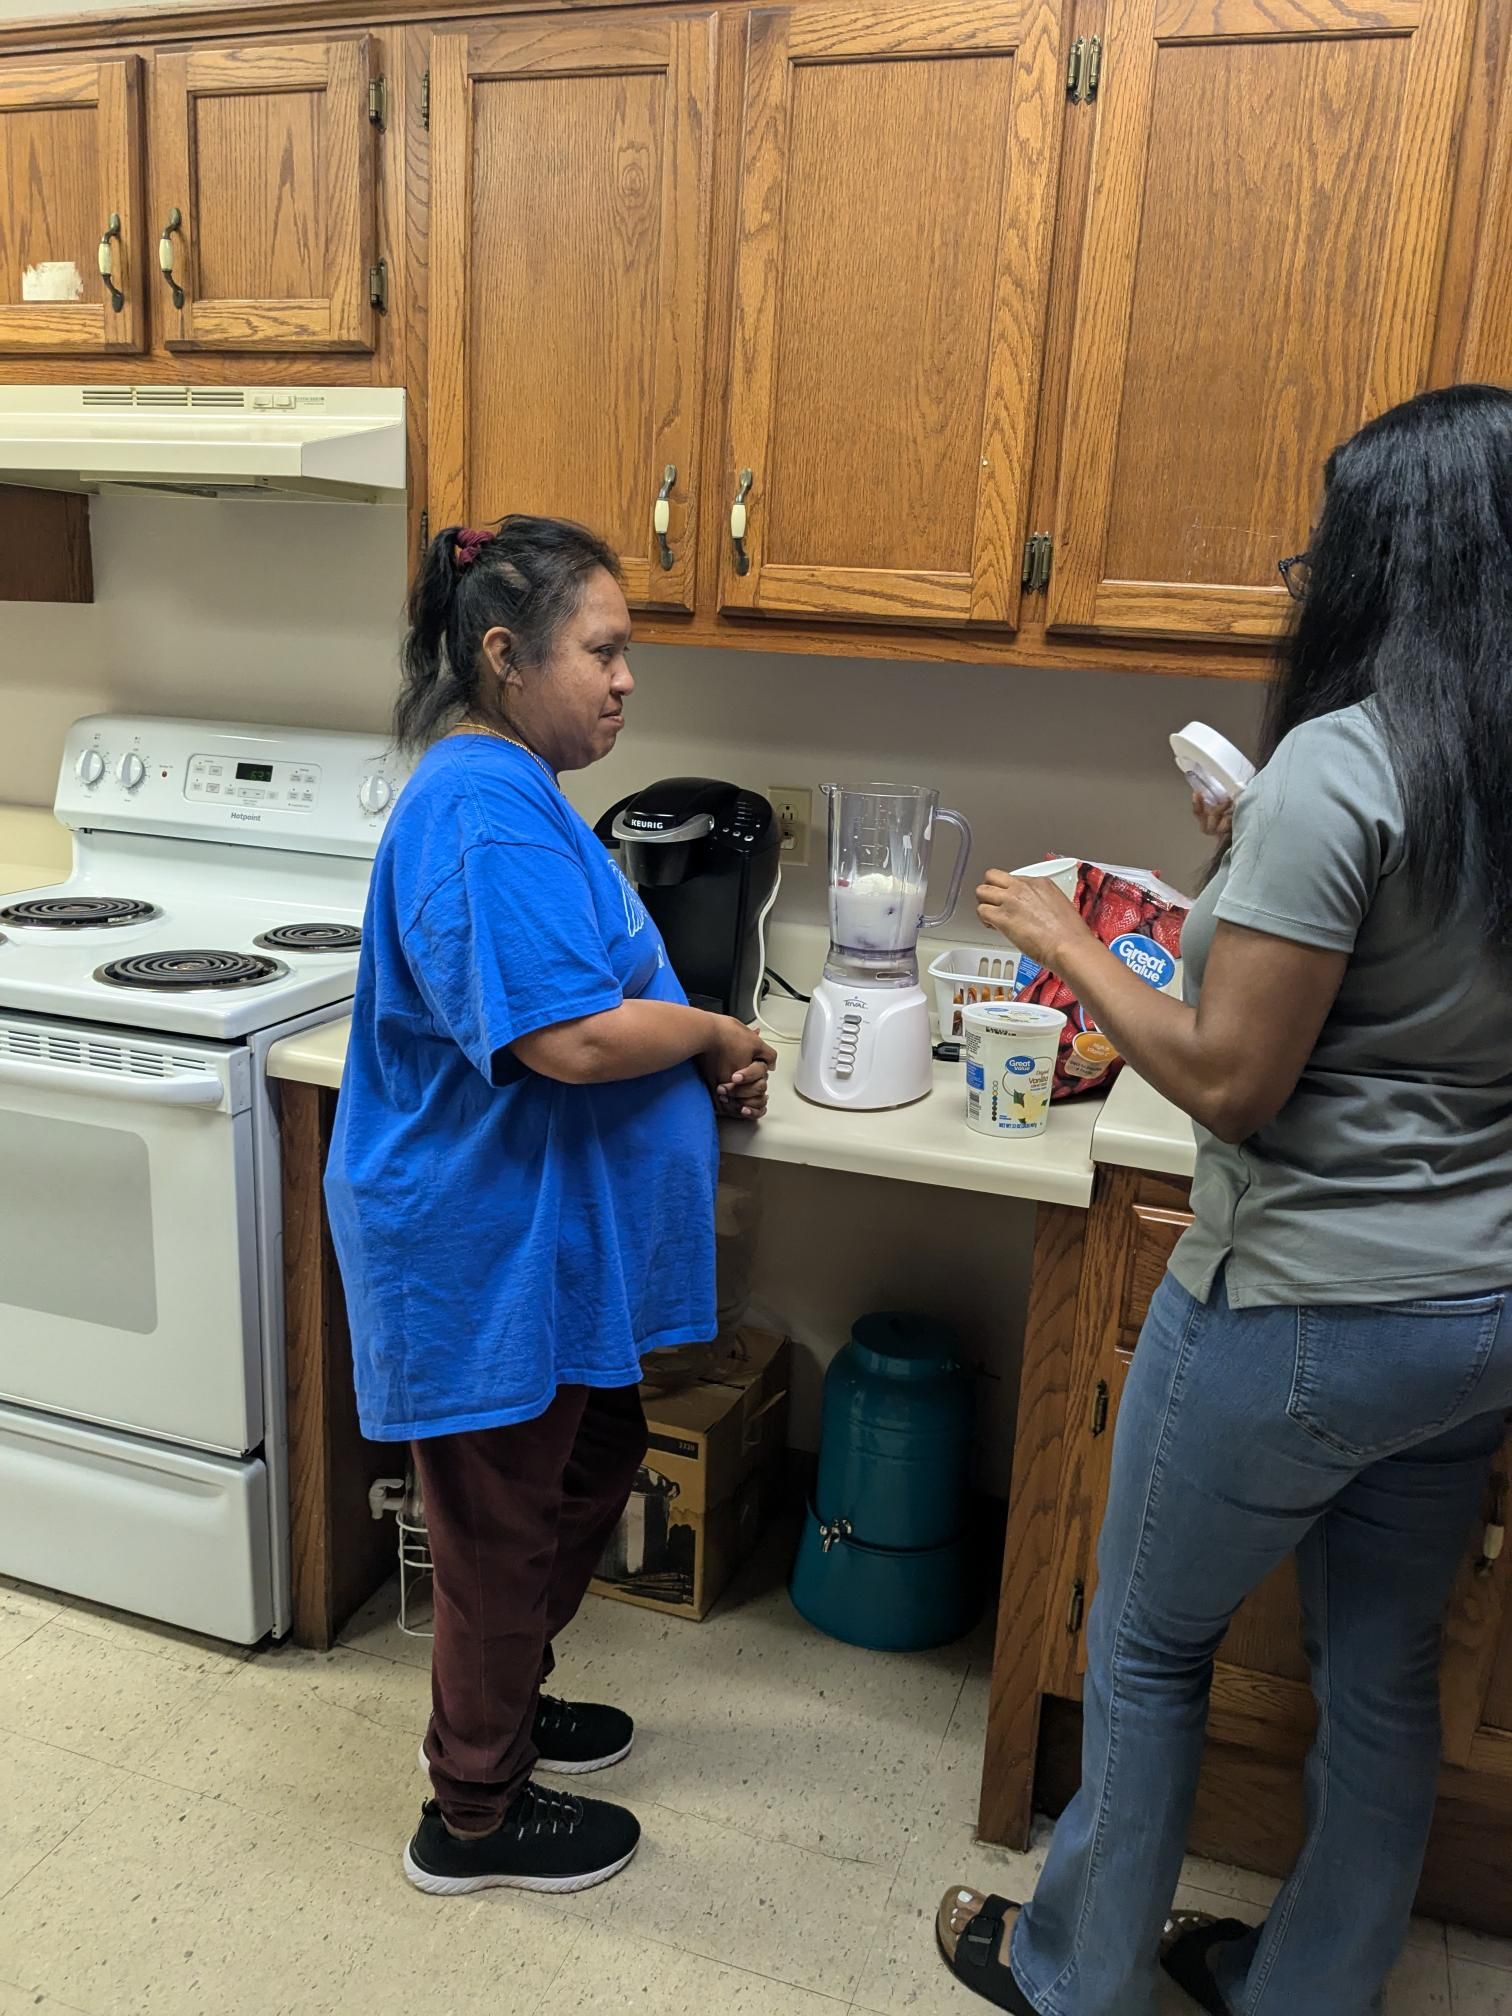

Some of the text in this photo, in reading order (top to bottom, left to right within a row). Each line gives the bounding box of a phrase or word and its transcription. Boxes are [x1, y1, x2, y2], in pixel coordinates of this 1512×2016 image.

[231, 812, 261, 821] Hotpoint
[631, 819, 664, 829] KEURIG
[1119, 940, 1167, 974] Great
[1126, 958, 1160, 982] Value
[844, 999, 868, 1009] RIVAL
[1009, 1059, 1031, 1067] Great
[1029, 1075, 1048, 1084] Vanilla
